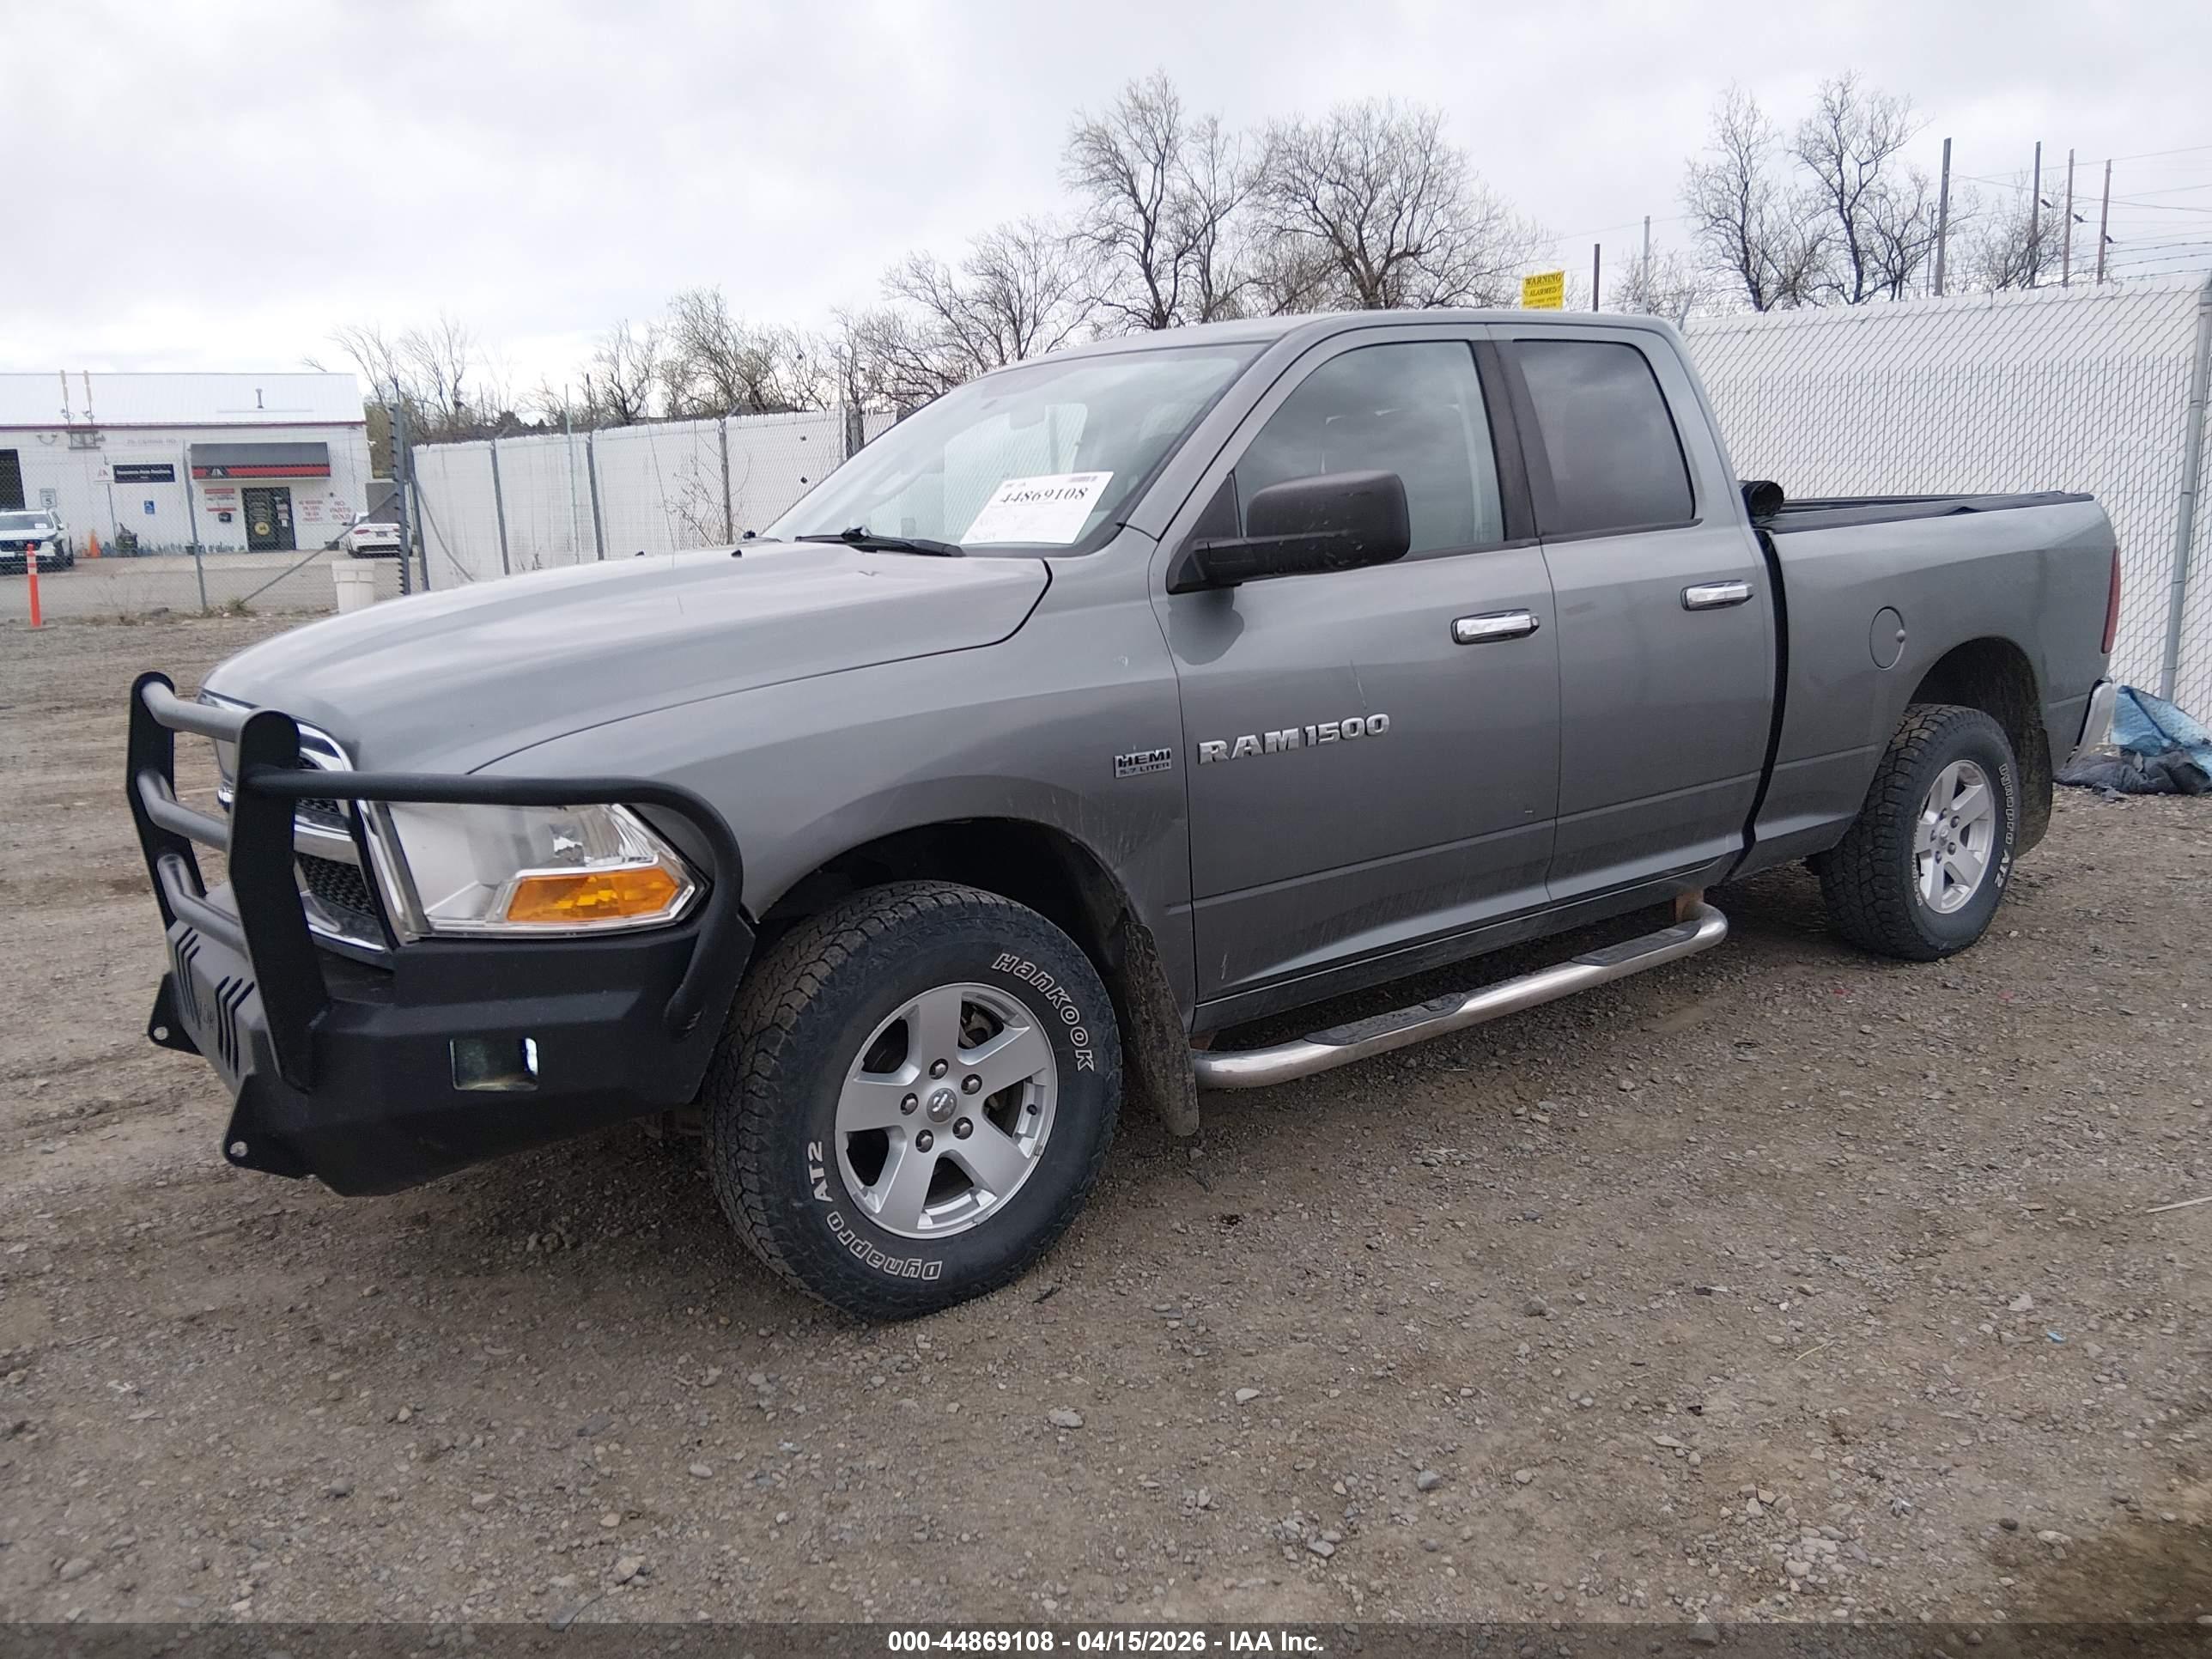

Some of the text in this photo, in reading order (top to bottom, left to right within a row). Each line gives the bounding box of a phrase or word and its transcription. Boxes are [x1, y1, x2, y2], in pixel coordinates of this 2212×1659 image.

[1525, 273, 1562, 287] WARNING
[1528, 287, 1557, 297] ALARMED
[46, 497, 53, 506] 5
[1000, 487, 1089, 503] 44869108
[1198, 714, 1390, 764] RAM 1500
[1117, 748, 1172, 768] HEMI
[1119, 761, 1171, 776] 5.7 LITER
[805, 1140, 834, 1202] AT2
